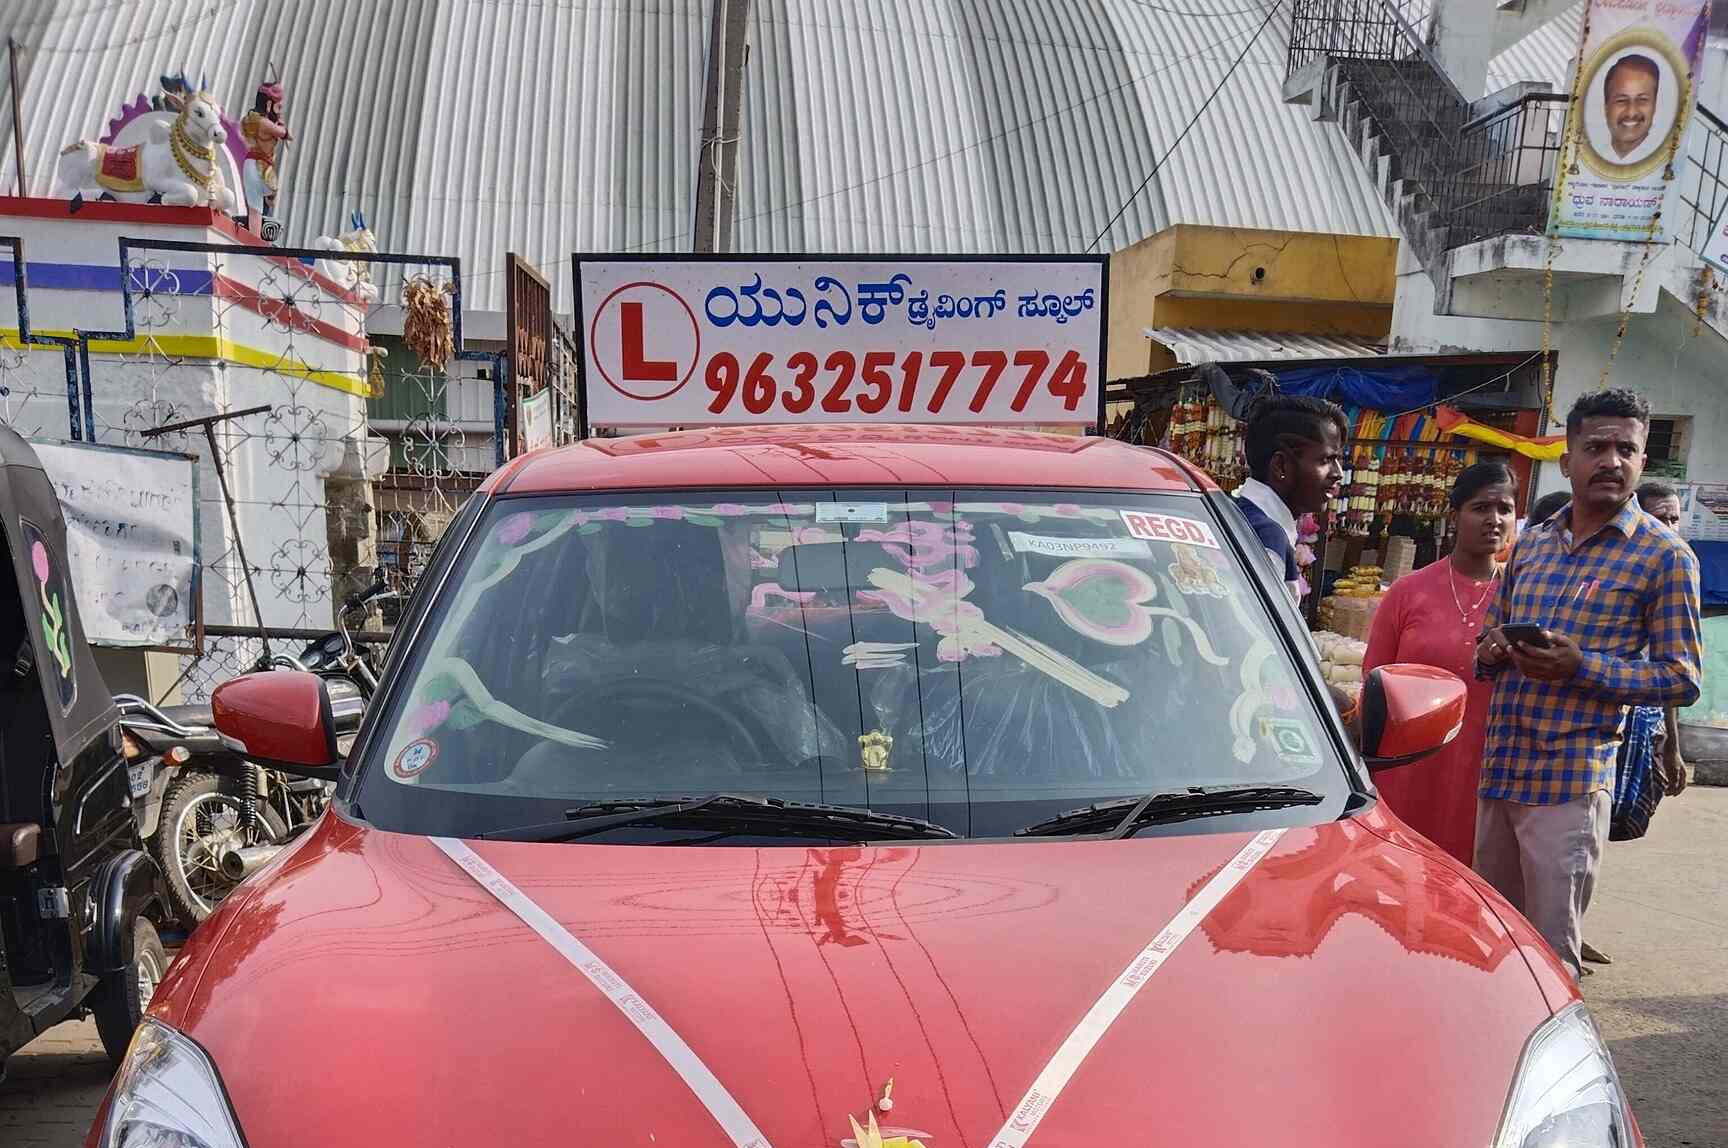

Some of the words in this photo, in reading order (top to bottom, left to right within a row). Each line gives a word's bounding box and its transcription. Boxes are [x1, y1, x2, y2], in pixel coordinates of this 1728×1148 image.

[705, 272, 912, 328] ಯುನಿಕ್
[908, 289, 1006, 330] ಡ್ರೈವಿಂಗ್
[1018, 288, 1095, 324] ಸ್ಕೂಲ್
[621, 302, 677, 381] L
[705, 350, 1088, 413] 9632517774
[1126, 514, 1216, 546] REGD.
